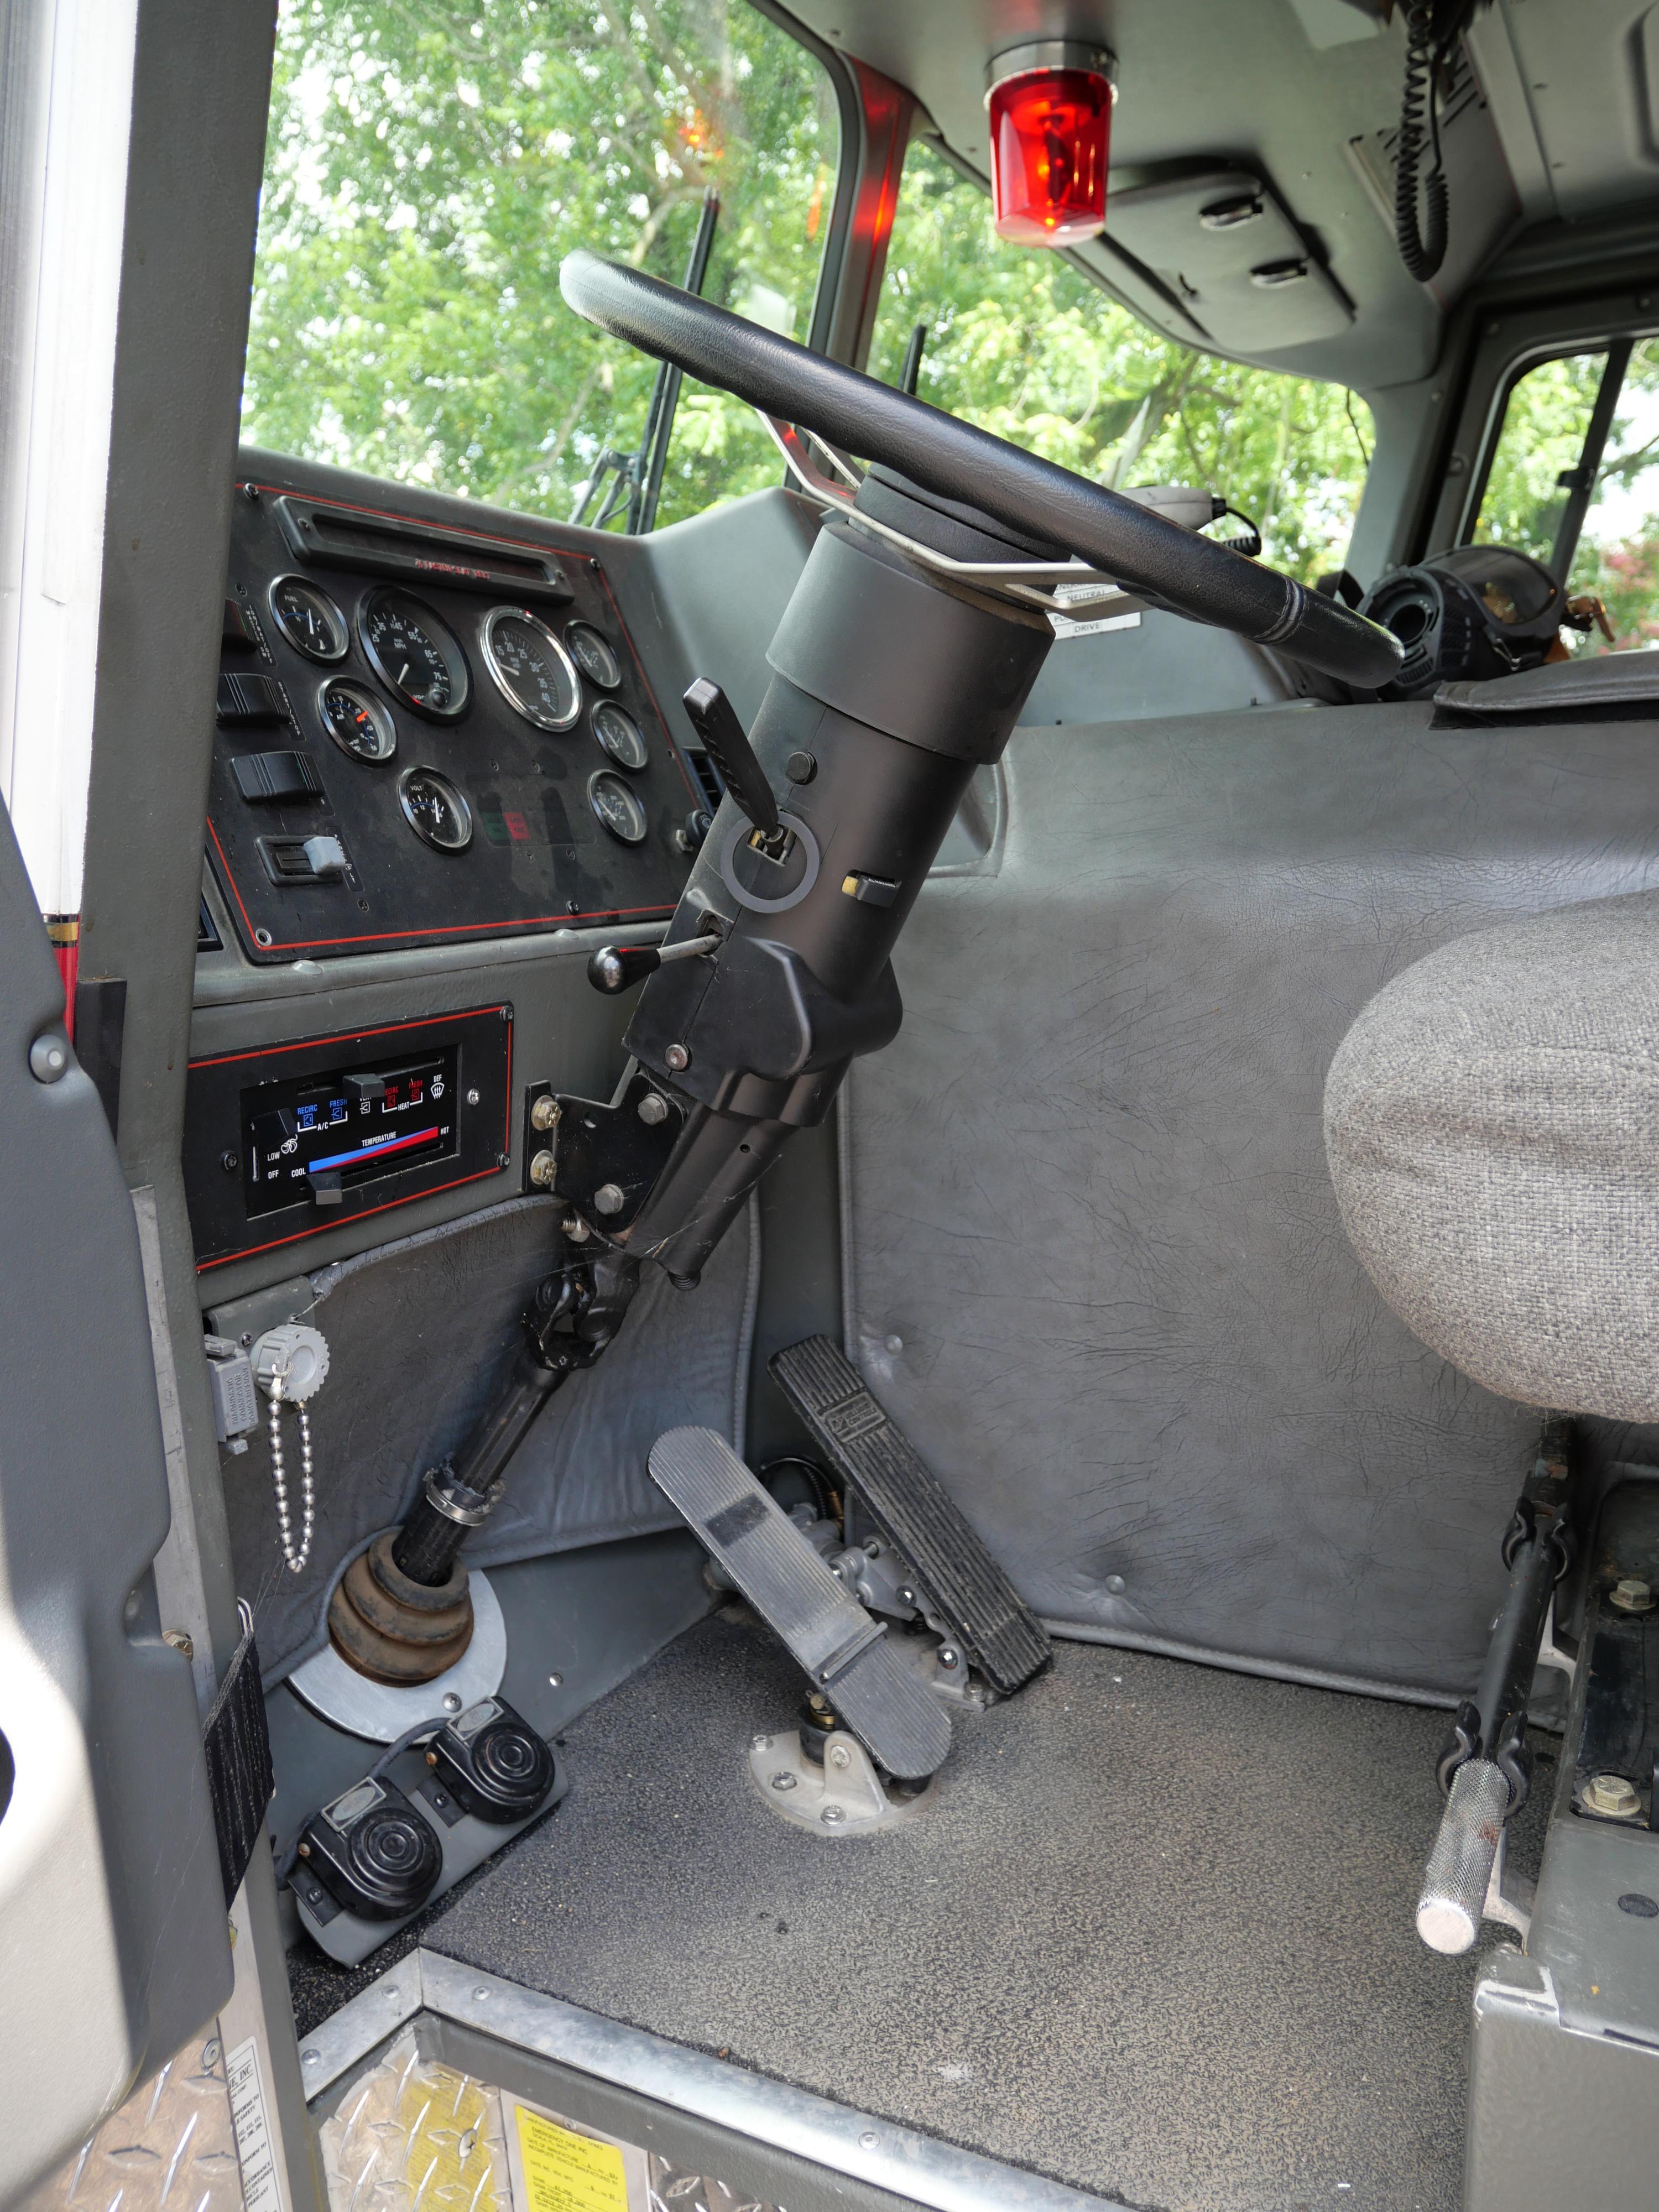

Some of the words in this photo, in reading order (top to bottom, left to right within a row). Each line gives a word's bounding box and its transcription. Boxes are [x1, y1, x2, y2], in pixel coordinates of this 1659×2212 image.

[284, 594, 299, 603] FUEL
[1067, 589, 1105, 602] NEUTRAL
[377, 622, 387, 632] 35
[395, 622, 403, 631] 45
[1074, 622, 1100, 633] DRIVE
[495, 645, 504, 656] 15
[504, 641, 514, 653] 20
[424, 649, 433, 659] 65
[434, 671, 442, 681] 75
[538, 677, 547, 688] 35
[278, 681, 300, 736] START/STOP
[408, 1079, 423, 1089] FRESH
[433, 1074, 442, 1083] DEF
[384, 1086, 399, 1095] ECIRC
[330, 1098, 348, 1108] FRESH
[398, 1101, 410, 1112] HEAT
[297, 1104, 318, 1115] RECIRC
[317, 1123, 328, 1131] A/C
[440, 1126, 450, 1135] HOT
[361, 1131, 397, 1147] TEMPERATURE
[267, 1151, 280, 1161] LOW
[268, 1170, 279, 1180] OFF
[291, 1167, 306, 1178] COOL
[227, 1378, 238, 1425] DIAGNOSTIC
[234, 1373, 247, 1421] CONNECTOR
[240, 2064, 253, 2080] INC.
[240, 2104, 255, 2121] SAFETY
